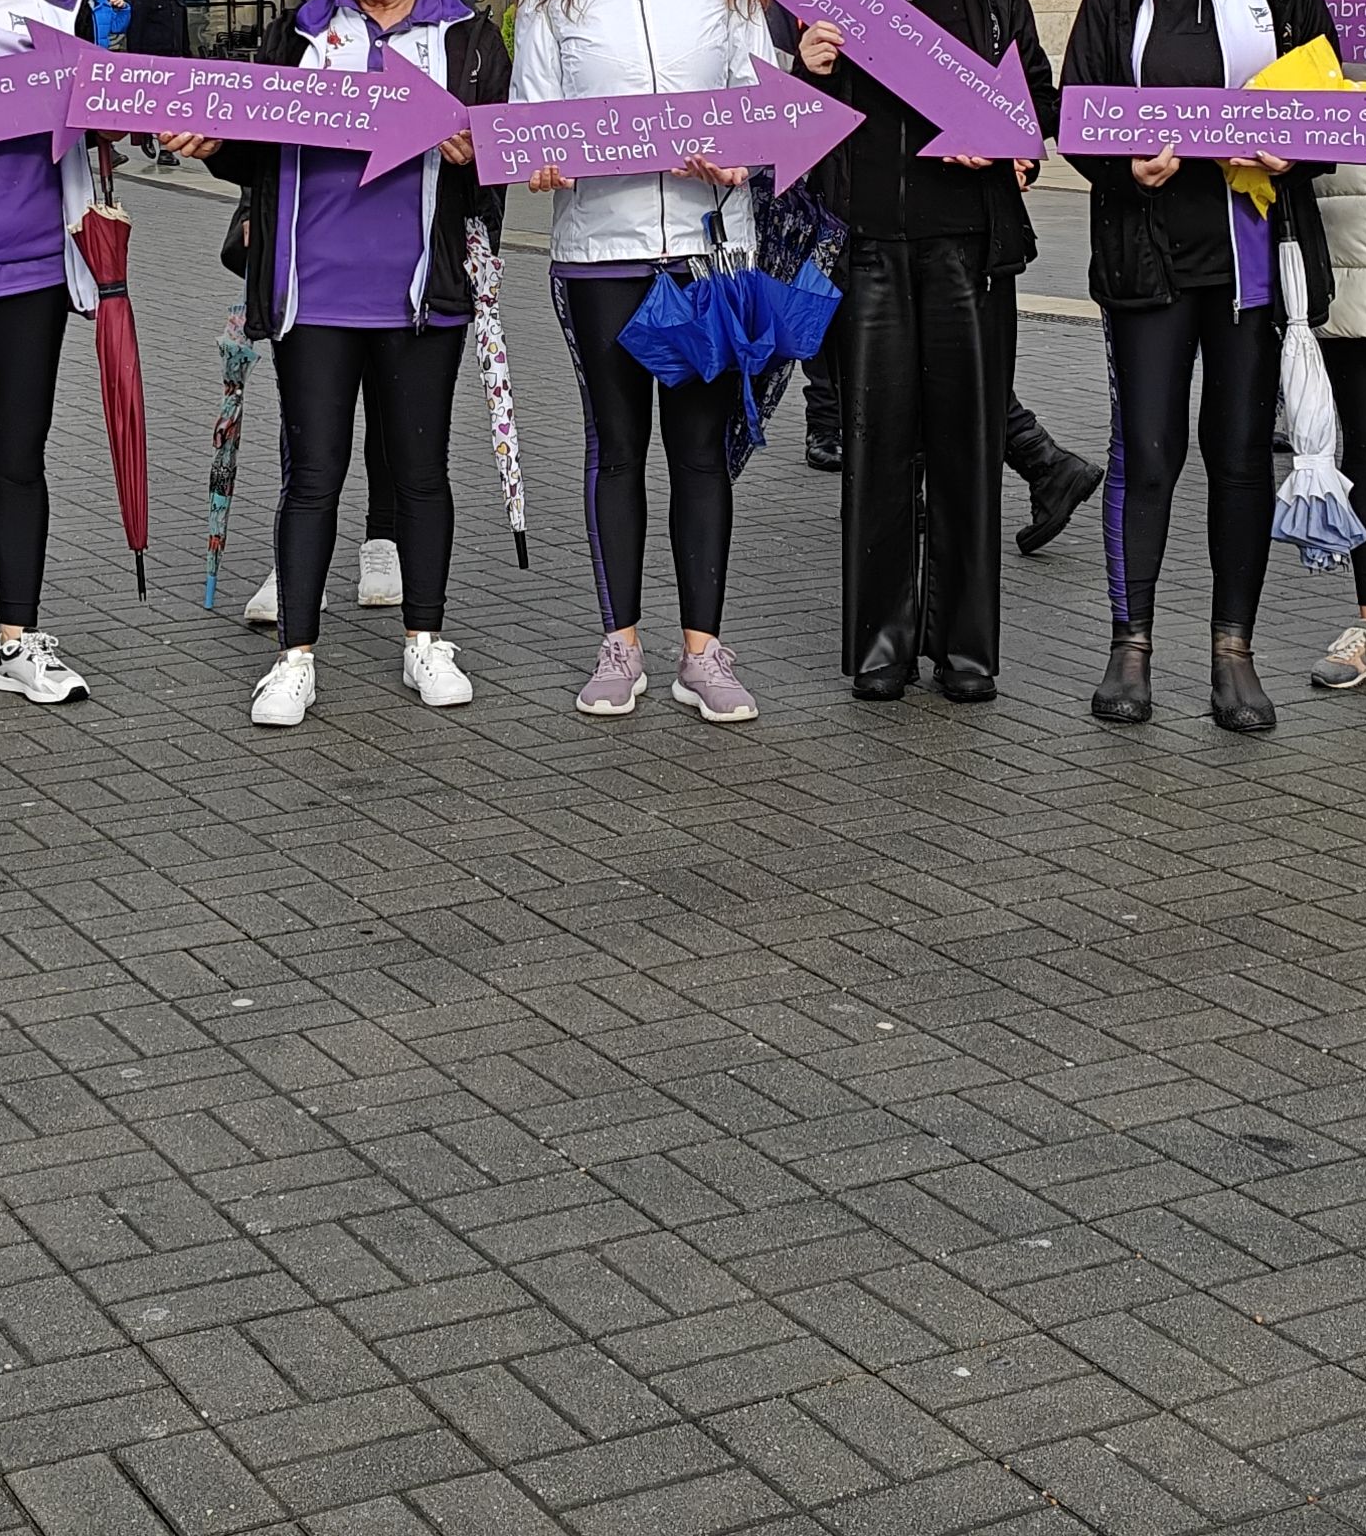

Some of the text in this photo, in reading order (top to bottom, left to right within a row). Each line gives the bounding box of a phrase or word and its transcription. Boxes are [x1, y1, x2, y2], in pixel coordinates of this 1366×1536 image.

[1336, 23, 1352, 38] er
[27, 70, 51, 86] es
[91, 62, 115, 82] El
[120, 67, 176, 86] amor
[177, 67, 253, 95] jamas
[341, 75, 360, 99] lo
[367, 84, 411, 110] que
[888, 15, 924, 47] son
[927, 37, 1038, 137] herramientas
[85, 87, 379, 132] duele es la violencia.
[492, 96, 824, 145] Somos el grito de las que
[1083, 96, 1124, 120] No
[1138, 104, 1168, 120] es
[1177, 104, 1210, 120] un
[1324, 108, 1352, 123] no
[1189, 122, 1292, 145] violencia
[501, 136, 723, 176] ya no tienen voz.
